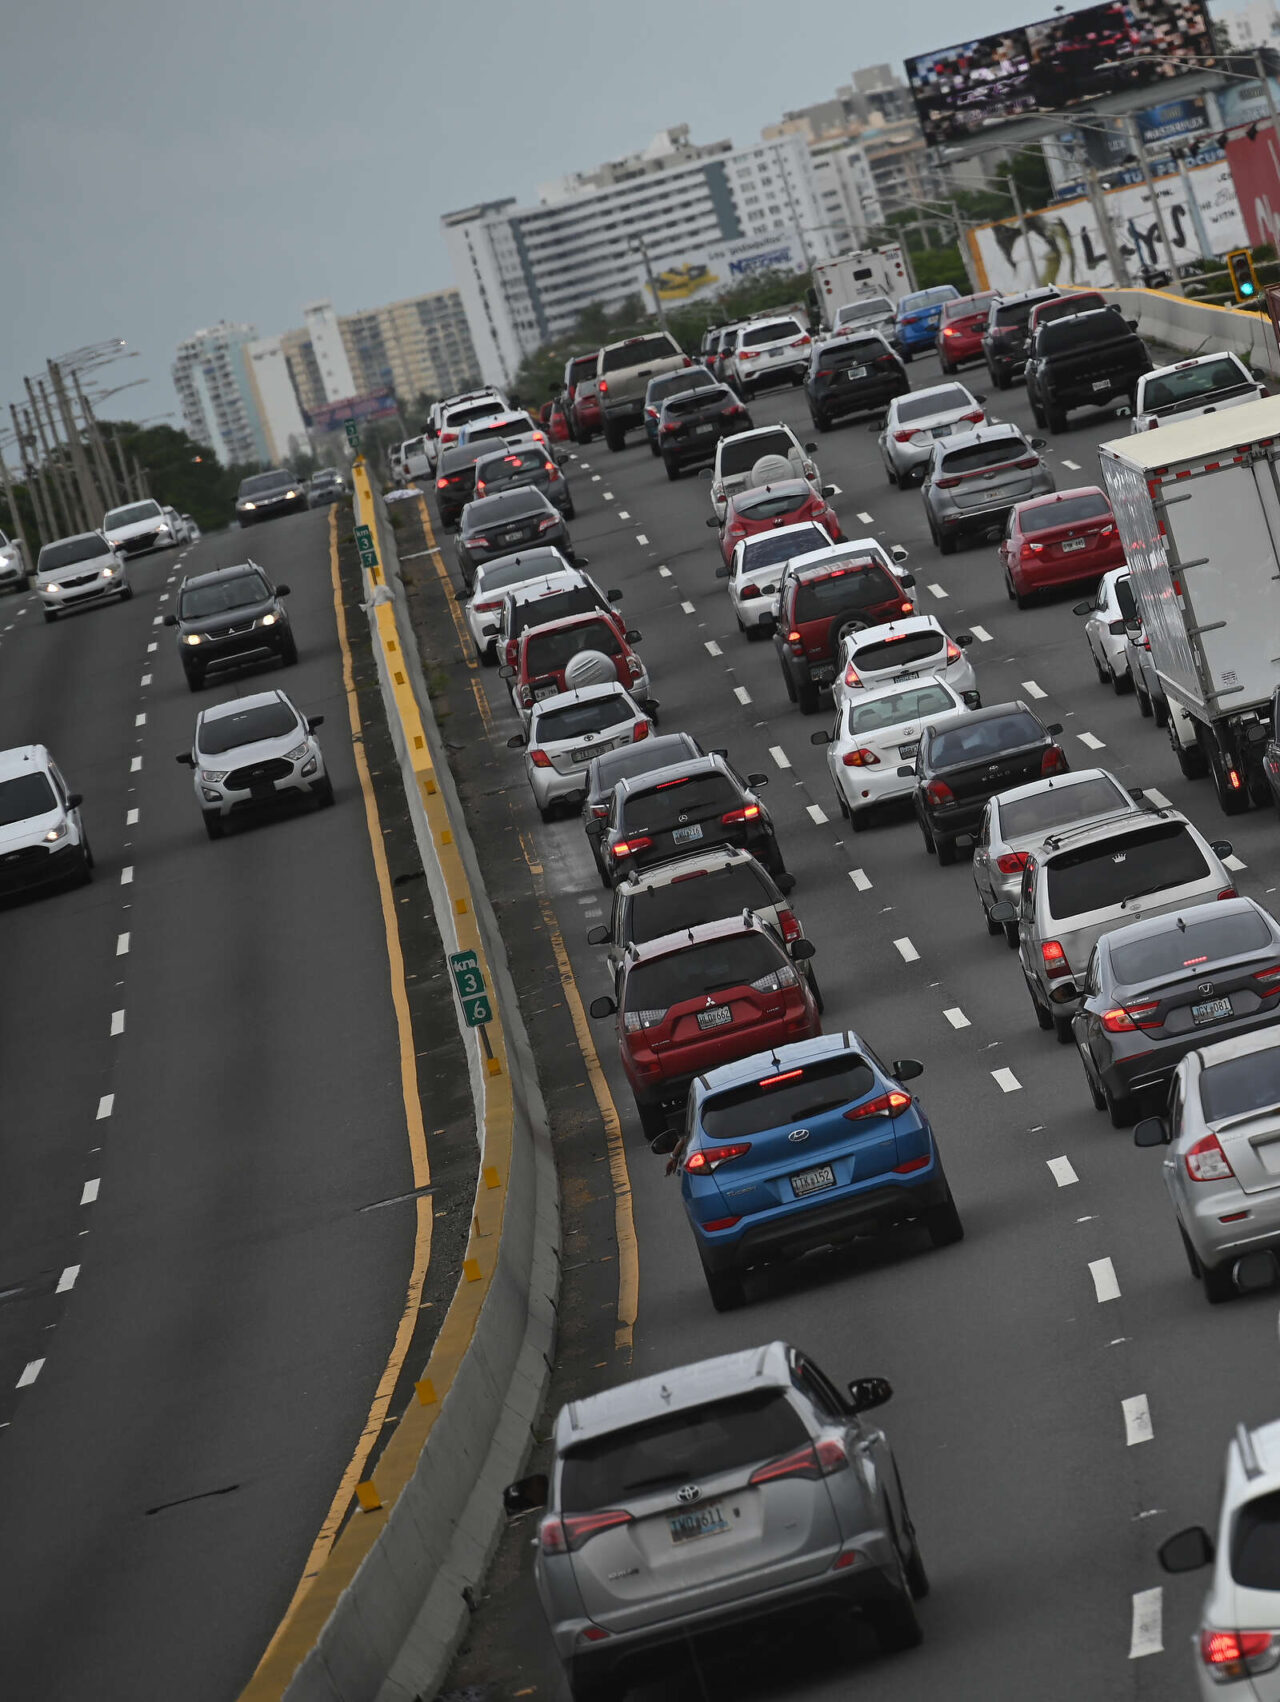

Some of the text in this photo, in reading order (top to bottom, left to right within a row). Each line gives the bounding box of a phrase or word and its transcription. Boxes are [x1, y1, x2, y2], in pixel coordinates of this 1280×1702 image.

[362, 538, 369, 549] 3
[454, 958, 476, 972] km
[464, 974, 478, 992] 3
[1213, 1000, 1230, 1013] 081
[716, 1008, 731, 1020] 662
[814, 1170, 831, 1184] 152
[701, 1506, 725, 1528] 611
